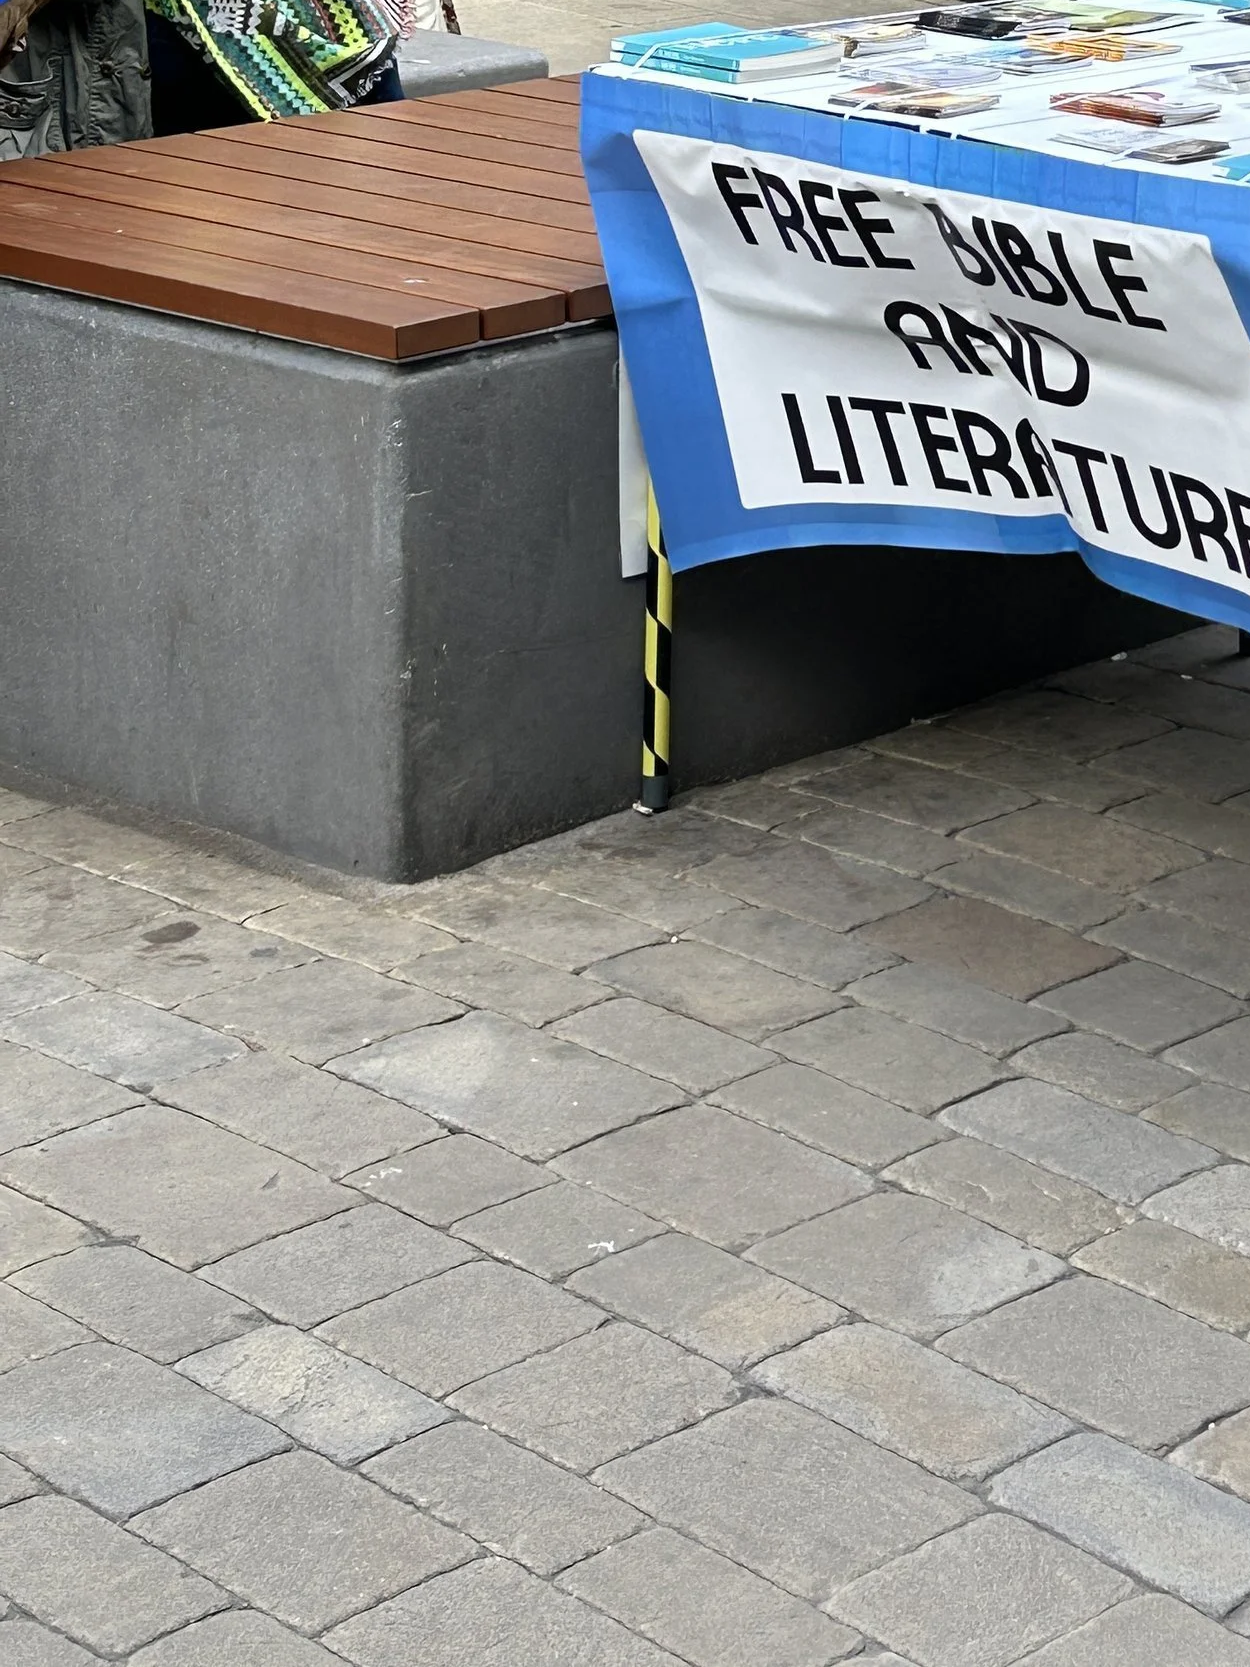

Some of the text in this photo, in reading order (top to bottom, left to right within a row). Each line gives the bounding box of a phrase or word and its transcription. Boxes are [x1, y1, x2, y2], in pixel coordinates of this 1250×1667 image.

[711, 162, 1167, 332] FREE BIBLE
[884, 300, 1090, 407] AND
